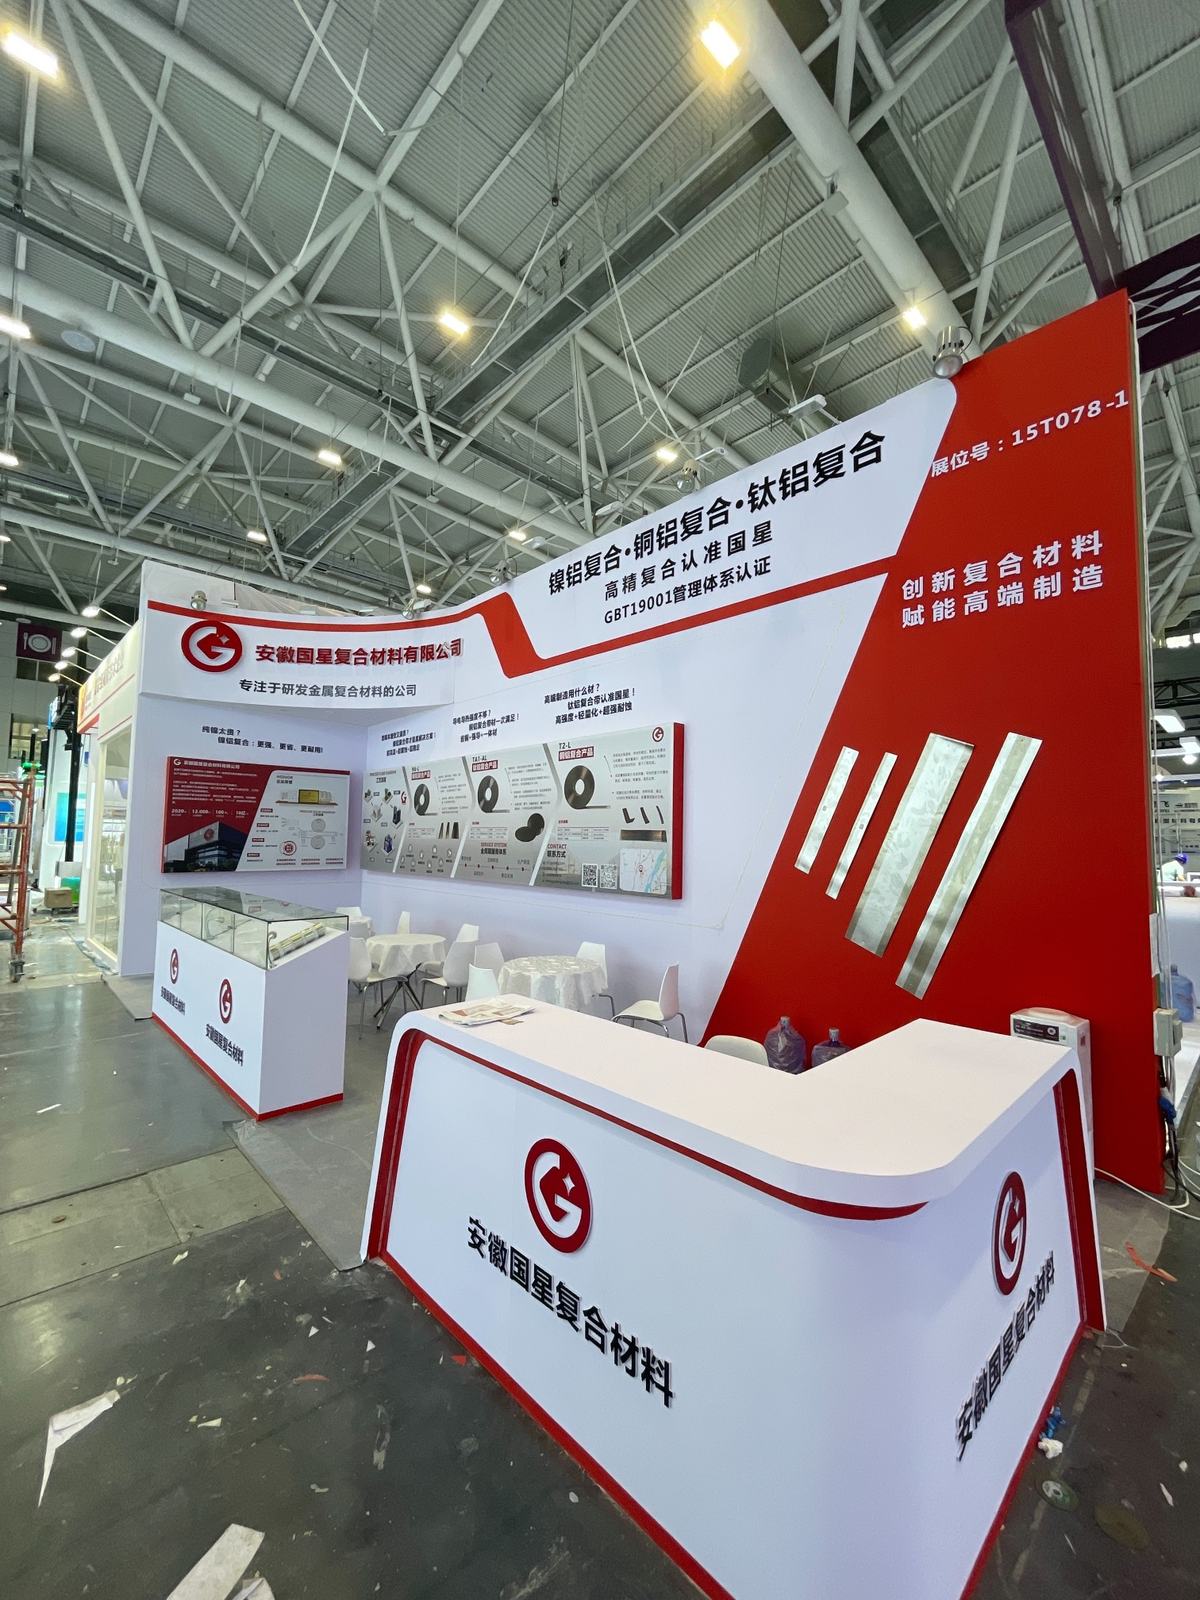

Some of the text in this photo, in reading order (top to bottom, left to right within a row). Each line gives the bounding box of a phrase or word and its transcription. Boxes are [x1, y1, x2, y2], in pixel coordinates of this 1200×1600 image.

[604, 520, 773, 602] 高精复合认准国星
[604, 555, 772, 624] GBT19001管理体系认证
[902, 530, 1103, 601] 创新复合材料
[902, 564, 1103, 628] 赋能高端制造
[256, 638, 465, 666] 安徽国星复合材料有限公司
[239, 678, 417, 698] 专注于研发金属复合材料的公司
[205, 1023, 244, 1067] 安徽国星复合材料
[467, 1215, 674, 1408] 安徽国星复合材料
[956, 1250, 1056, 1462] 安徽国星复合材料
